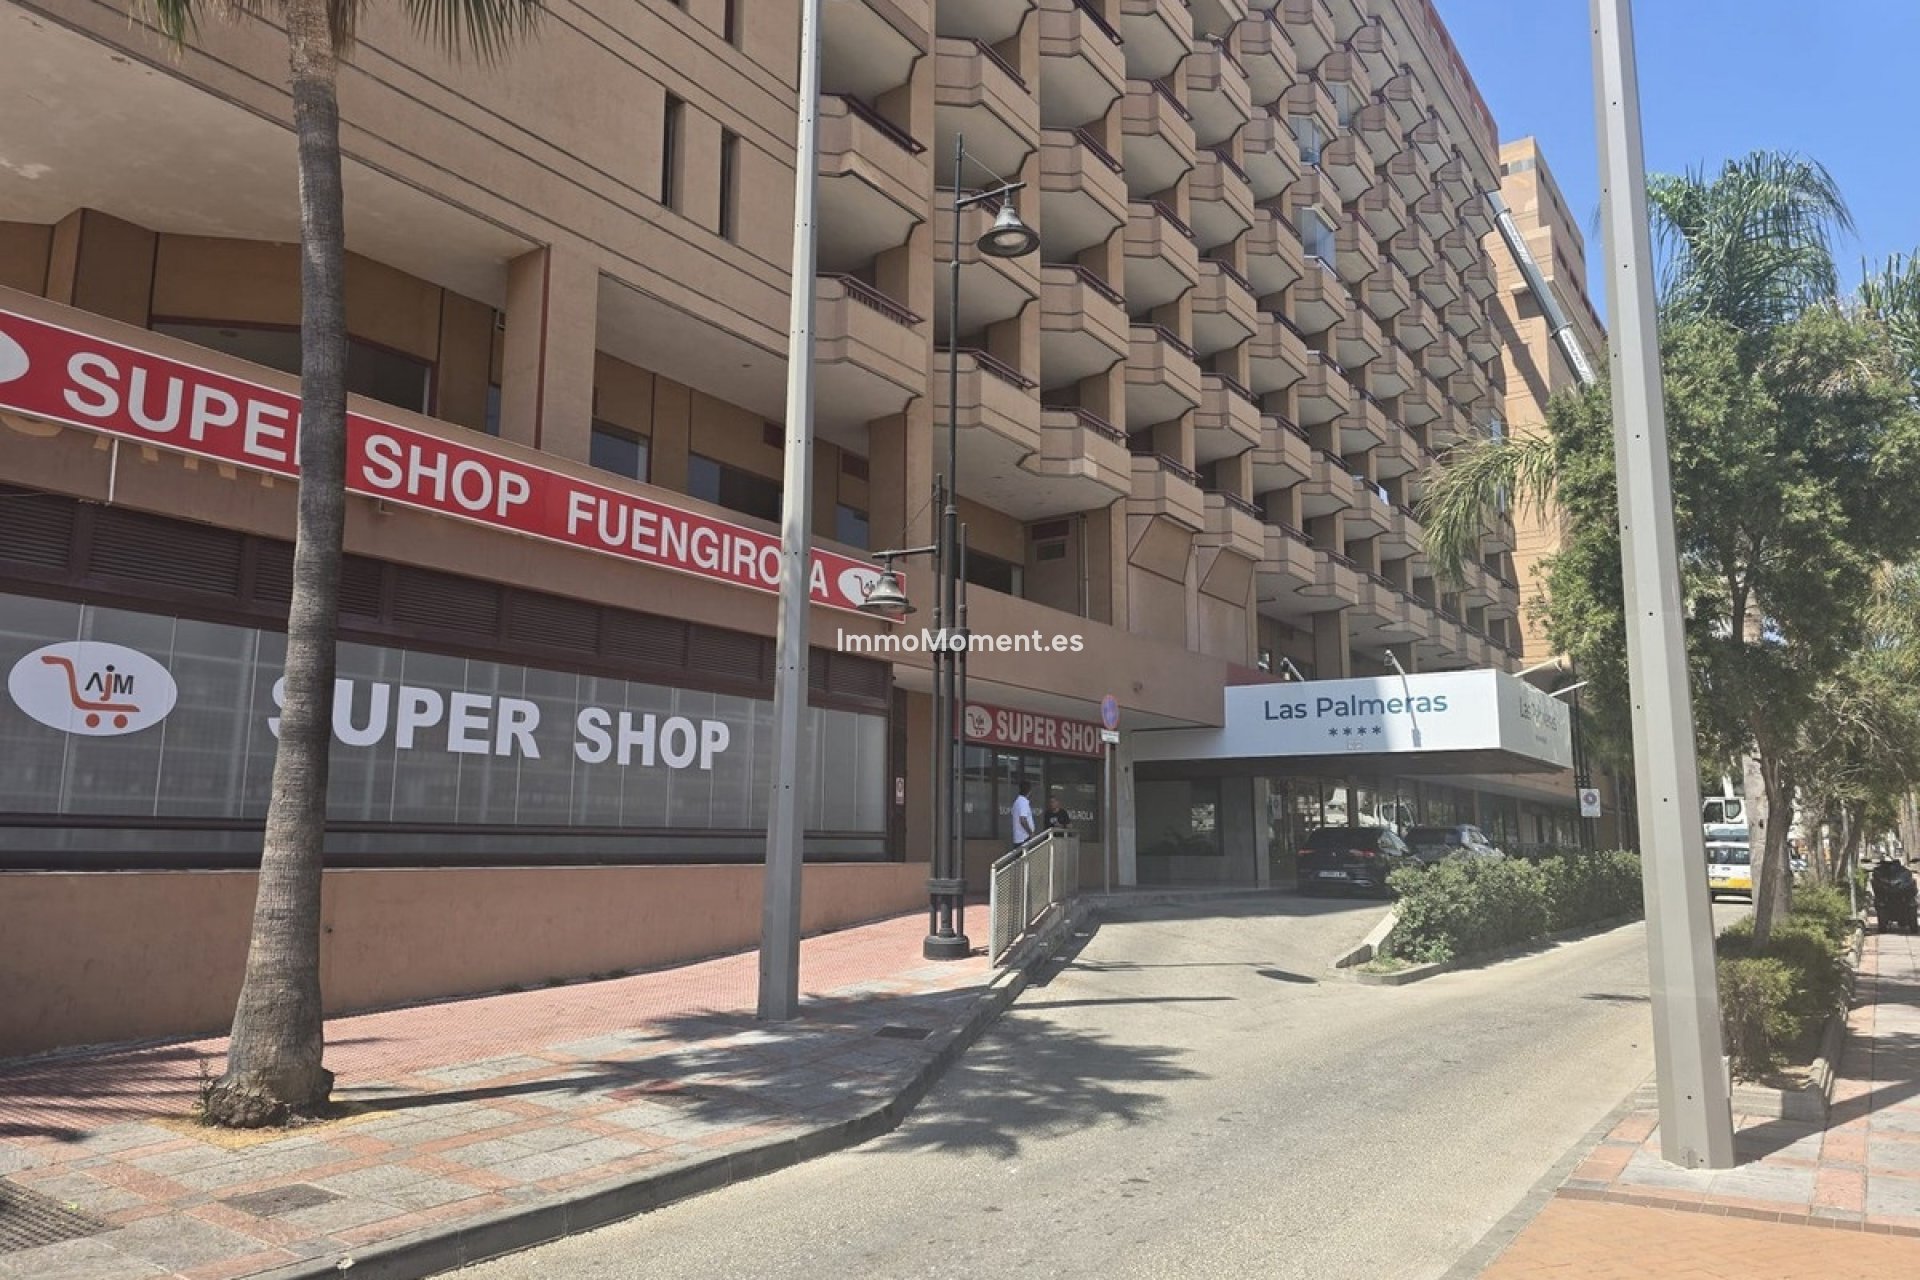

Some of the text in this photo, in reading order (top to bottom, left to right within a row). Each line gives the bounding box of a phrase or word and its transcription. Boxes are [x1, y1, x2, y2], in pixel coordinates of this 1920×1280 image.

[63, 351, 829, 598] SUPE SHOP FUENGIROA
[997, 710, 1057, 748] SUPER
[1265, 695, 1448, 721] Las Palmeras
[575, 706, 730, 771] SHOP
